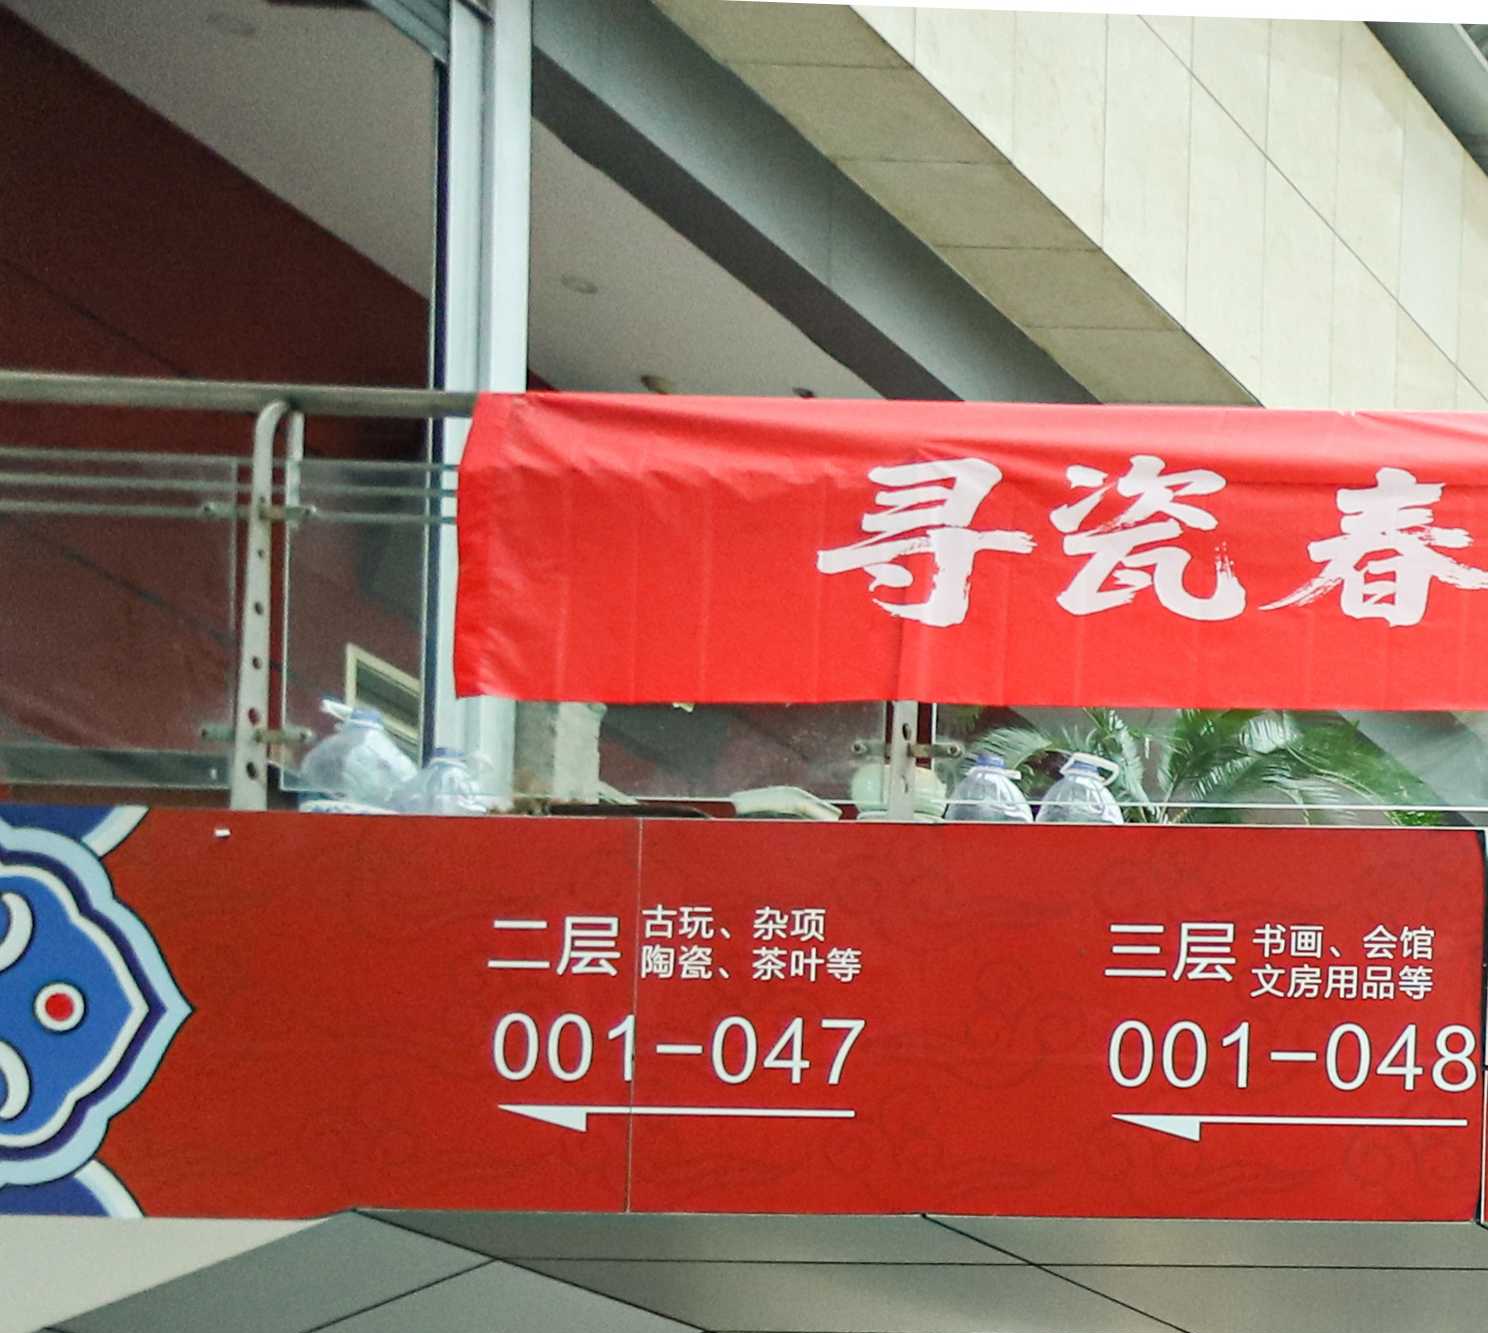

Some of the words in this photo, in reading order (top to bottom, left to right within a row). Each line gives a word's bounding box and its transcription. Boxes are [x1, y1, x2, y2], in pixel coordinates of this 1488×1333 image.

[488, 916, 621, 976] 二层
[642, 904, 827, 942] 古玩、杂项
[1252, 923, 1435, 960] 书画、会馆
[640, 944, 862, 983] 陶瓷、茶叶等
[1104, 922, 1237, 982] 三层
[1250, 963, 1434, 1000] 文房用品等
[493, 1013, 866, 1085] 001-047
[1109, 1020, 1478, 1092] 001-048
